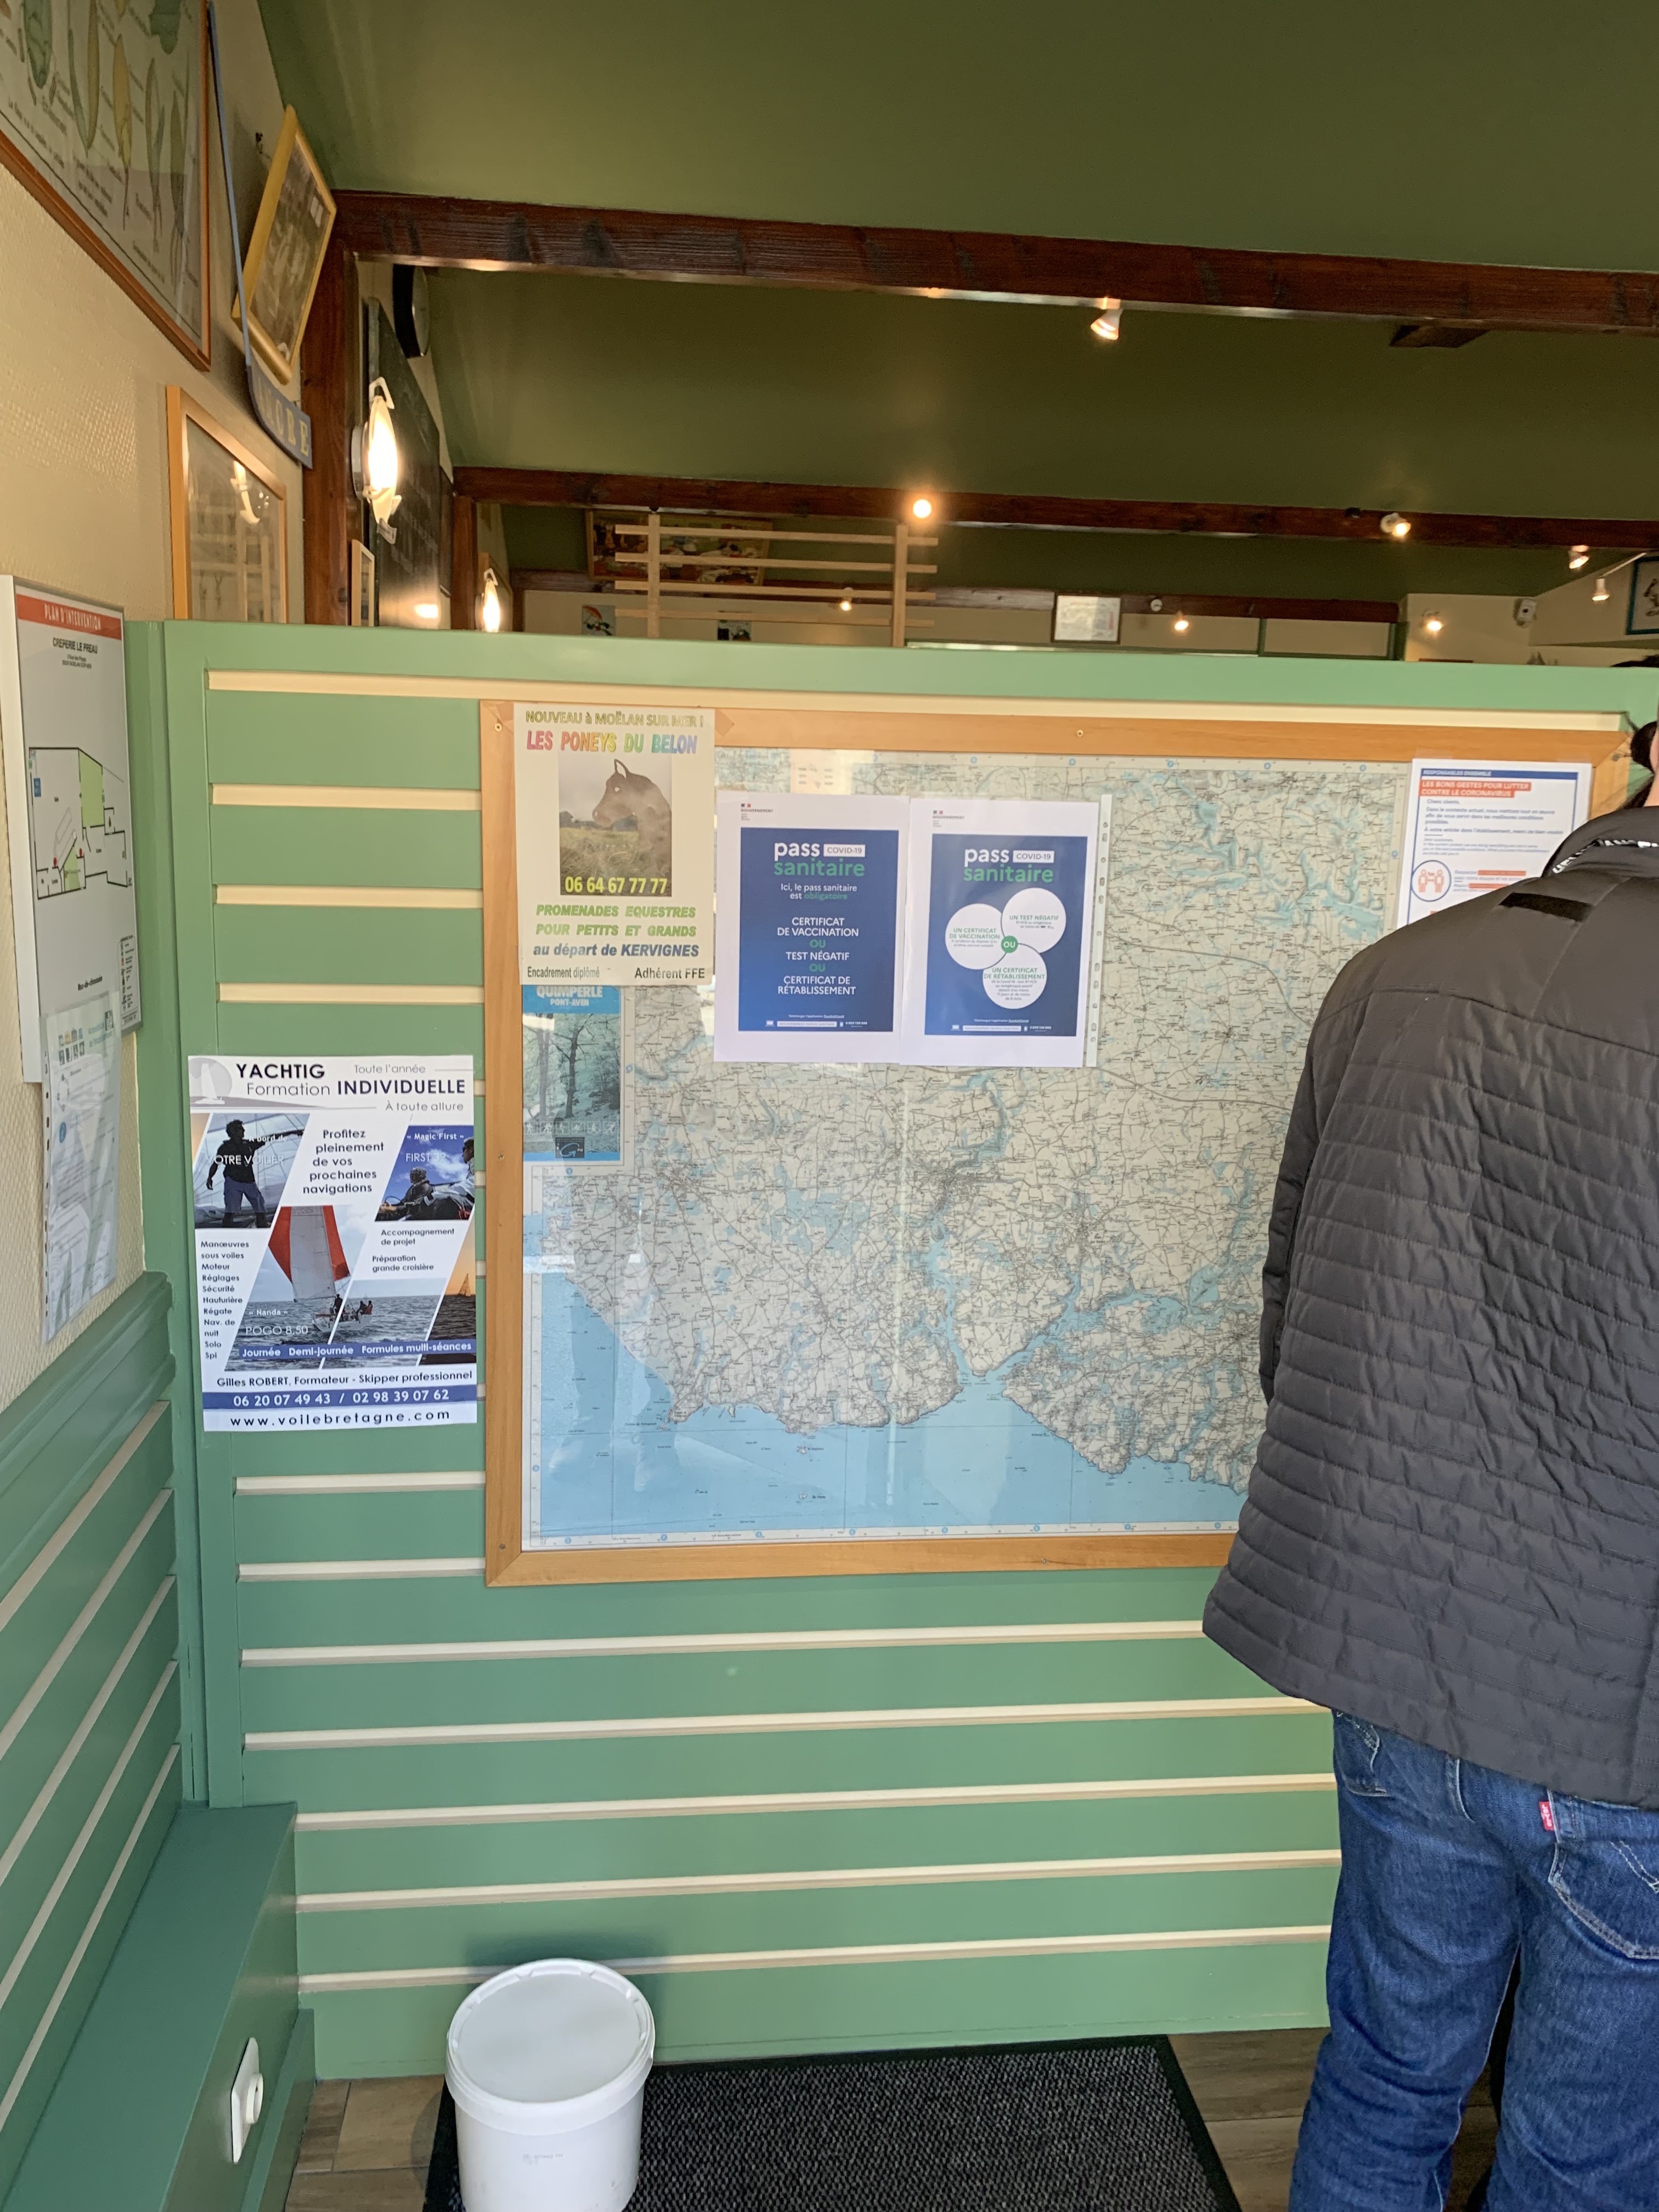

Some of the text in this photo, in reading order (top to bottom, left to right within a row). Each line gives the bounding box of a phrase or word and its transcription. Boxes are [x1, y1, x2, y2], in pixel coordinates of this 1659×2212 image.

[44, 603, 59, 621] PLAN
[77, 642, 82, 652] LE
[526, 710, 583, 724] NOUVEAU
[595, 710, 644, 726] MOËLAN
[646, 713, 669, 726] SUR
[672, 714, 698, 727] MER
[526, 730, 698, 755] LES PONEYS DU BELON
[774, 842, 821, 862] pass
[964, 848, 1010, 868] pass
[774, 857, 865, 877] sanitaire
[963, 863, 1054, 883] sanitaire
[565, 876, 668, 894] 06 64 67 77 77
[781, 883, 857, 893] Ici, le pass sanitaire
[804, 893, 848, 901] obligatoire
[535, 904, 696, 918] PROMENADES EQUESTRES
[792, 917, 845, 927] CERTIFICAT
[535, 923, 697, 938] POUR PETITS ET GRANDS
[777, 927, 859, 937] DE VACCINATION
[809, 939, 826, 948] OU
[533, 943, 700, 960] au départ de KERVIGNES
[786, 950, 850, 961] TEST NÉGATIF
[809, 963, 826, 972] OU
[527, 967, 706, 980] Encadrement diplômé Adhérent FFE
[783, 975, 850, 985] CERTIFICAT DE
[777, 983, 856, 995] RÉTABLISSEMENT
[236, 1063, 426, 1079] YACHTIG Toute l'année
[247, 1079, 466, 1096] Formation INDIVIDUELLE
[385, 1100, 464, 1111] À toute allure
[323, 1129, 366, 1139] Profitez
[414, 1133, 437, 1142] Magic
[315, 1142, 385, 1154] pleinement
[206, 1154, 285, 1165] VOTRE VOILIER
[312, 1157, 353, 1167] de vos
[405, 1153, 431, 1163] FIRST
[309, 1170, 377, 1182] prochaines
[303, 1183, 373, 1195] navigations
[380, 1228, 455, 1238] Accompagnement
[393, 1238, 416, 1247] projet
[372, 1255, 416, 1264] Préparation
[372, 1263, 435, 1273] grande croisière
[202, 1274, 240, 1283] Réglages
[202, 1285, 235, 1293] Sécurité
[202, 1296, 243, 1304] Hauturière
[203, 1307, 233, 1316] Régate
[245, 1325, 283, 1336] POGO
[242, 1341, 472, 1358] Journée Demi-journée Formules multi-séances
[205, 1352, 218, 1361] Spi
[217, 1377, 246, 1387] Gilles
[294, 1375, 349, 1385] Formateur
[358, 1373, 399, 1385] Skipper
[402, 1370, 472, 1384] professionnel
[233, 1395, 250, 1407] 06
[253, 1395, 270, 1407] 20
[274, 1394, 291, 1406] 07
[294, 1393, 311, 1405] 49
[314, 1392, 331, 1405] 43
[352, 1391, 369, 1404] 02
[373, 1391, 390, 1403] 98
[393, 1390, 409, 1402] 39
[413, 1390, 430, 1402] 07
[433, 1389, 450, 1401] 62
[230, 1410, 450, 1427] www.voilebretagne.com
